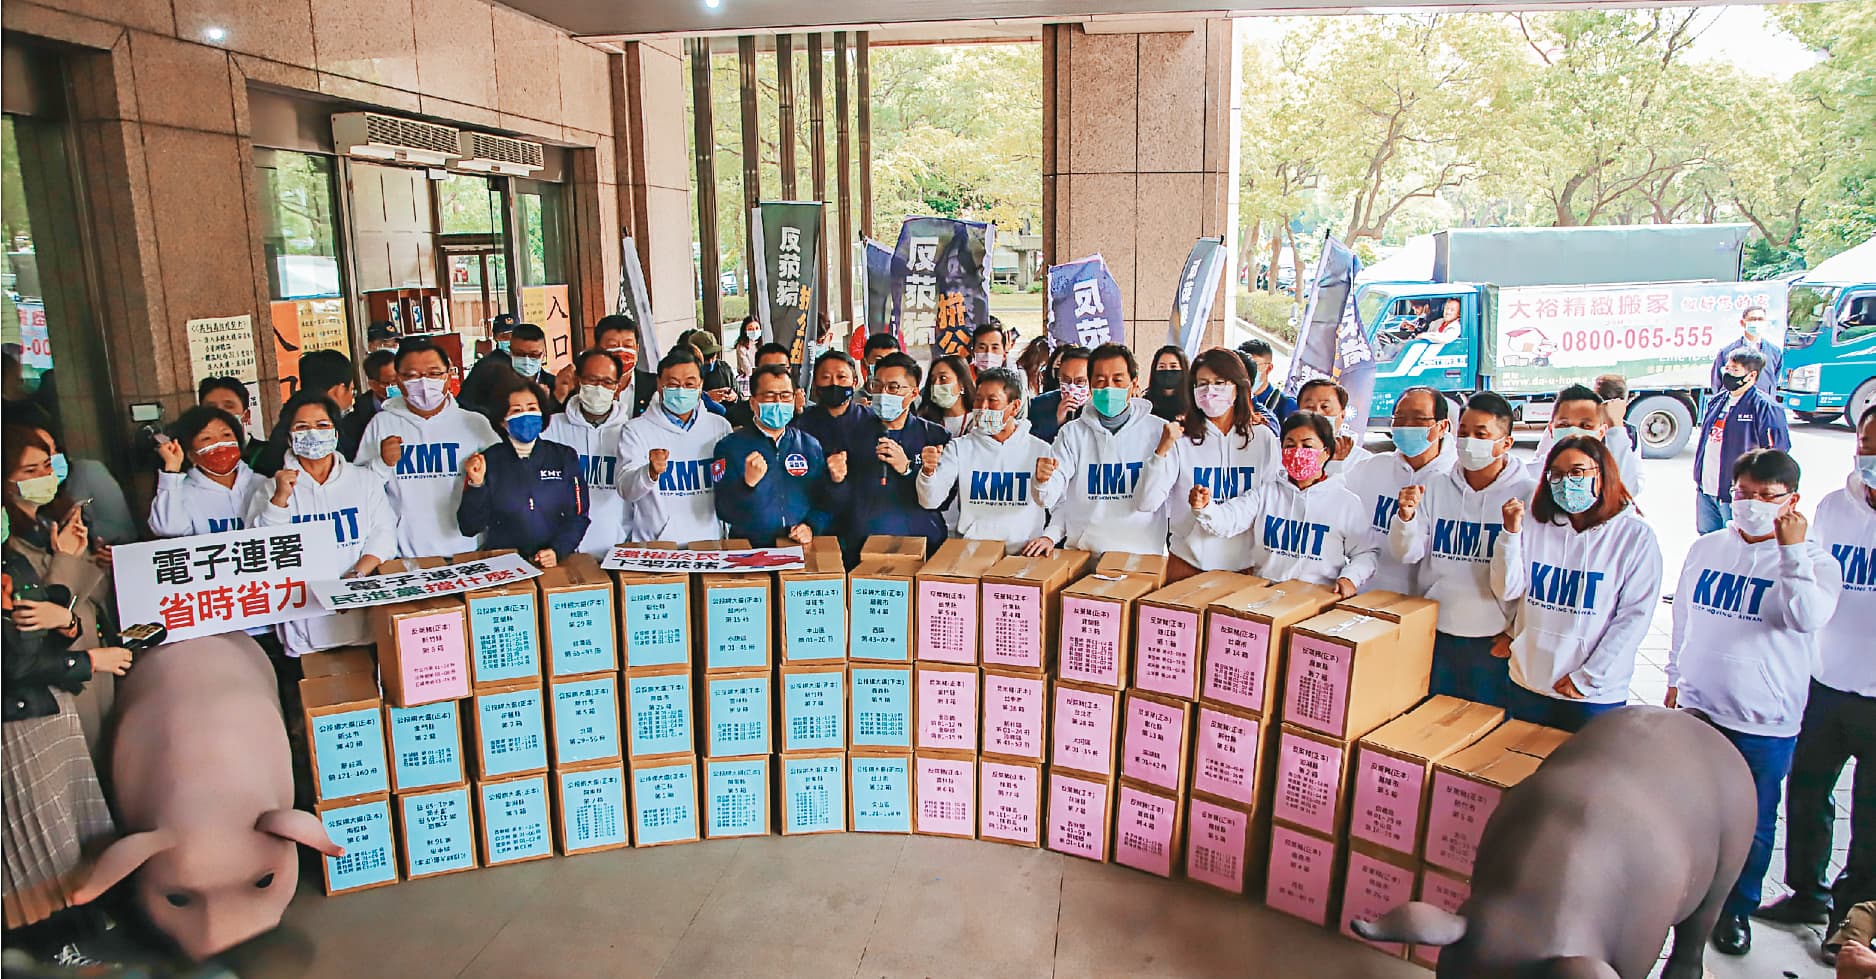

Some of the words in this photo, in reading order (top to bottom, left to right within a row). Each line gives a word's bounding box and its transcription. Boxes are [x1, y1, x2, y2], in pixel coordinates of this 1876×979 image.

[1508, 294, 1670, 321] 大裕精緻搬家
[546, 296, 569, 359] 入口
[1562, 326, 1713, 352] 0800-065-555
[396, 442, 460, 474] KMT
[659, 458, 714, 491] KMT
[969, 470, 1031, 502] KMT
[1087, 461, 1143, 495] KMT
[1193, 466, 1256, 499] KMT
[1263, 514, 1330, 556] KMT
[1432, 517, 1503, 558] KMT
[152, 533, 303, 585] 電子連署
[345, 562, 491, 591] 電子連署
[1528, 561, 1604, 609] KMT
[1692, 568, 1774, 616] KMT
[159, 576, 307, 631] 省時省力
